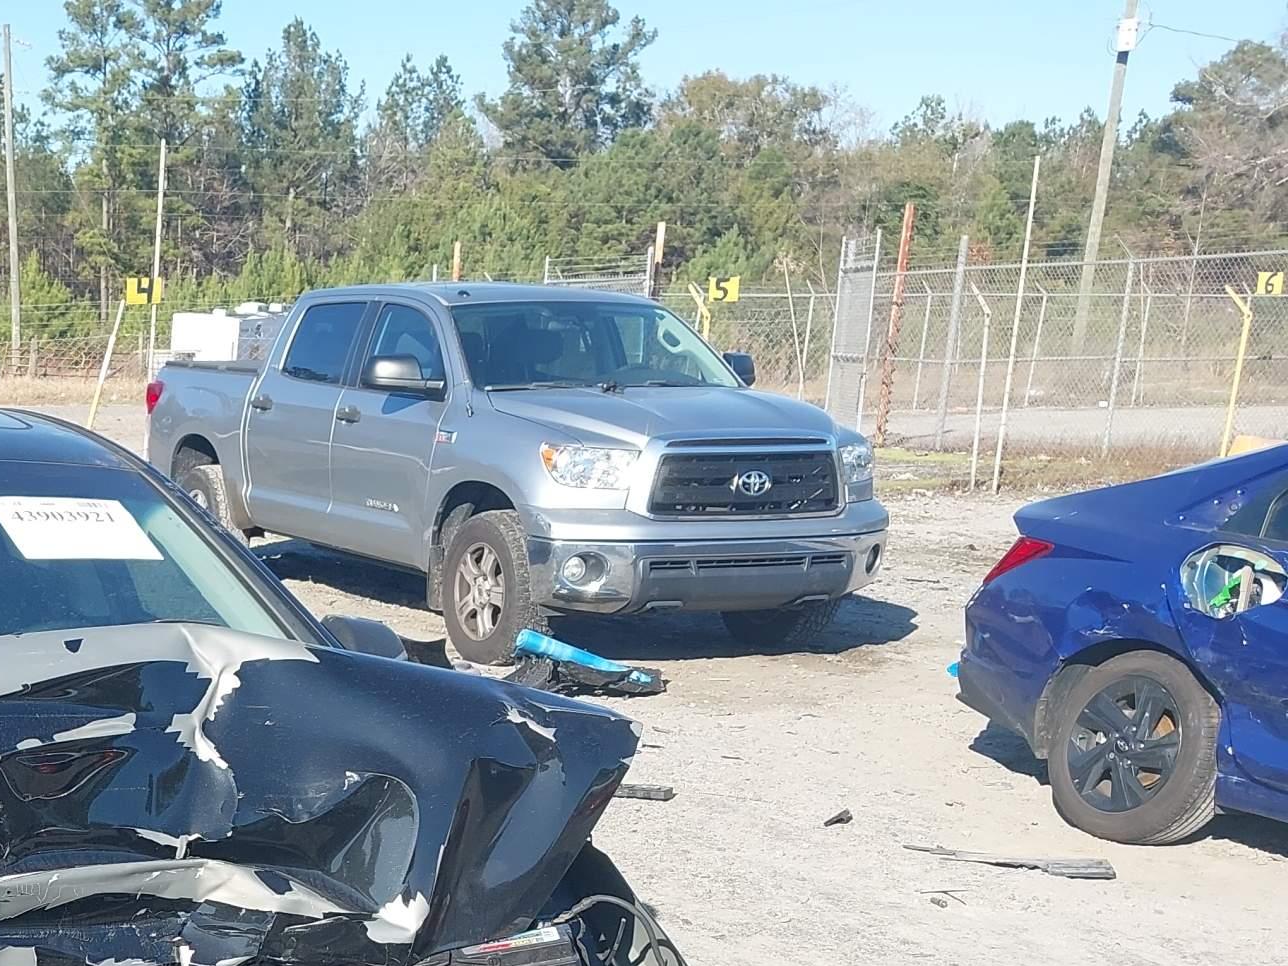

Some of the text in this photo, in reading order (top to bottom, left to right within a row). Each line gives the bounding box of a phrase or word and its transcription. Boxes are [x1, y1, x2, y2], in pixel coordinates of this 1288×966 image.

[137, 277, 153, 303] 4
[713, 277, 730, 301] 5
[1265, 272, 1278, 294] 6
[12, 510, 115, 523] 43903921
